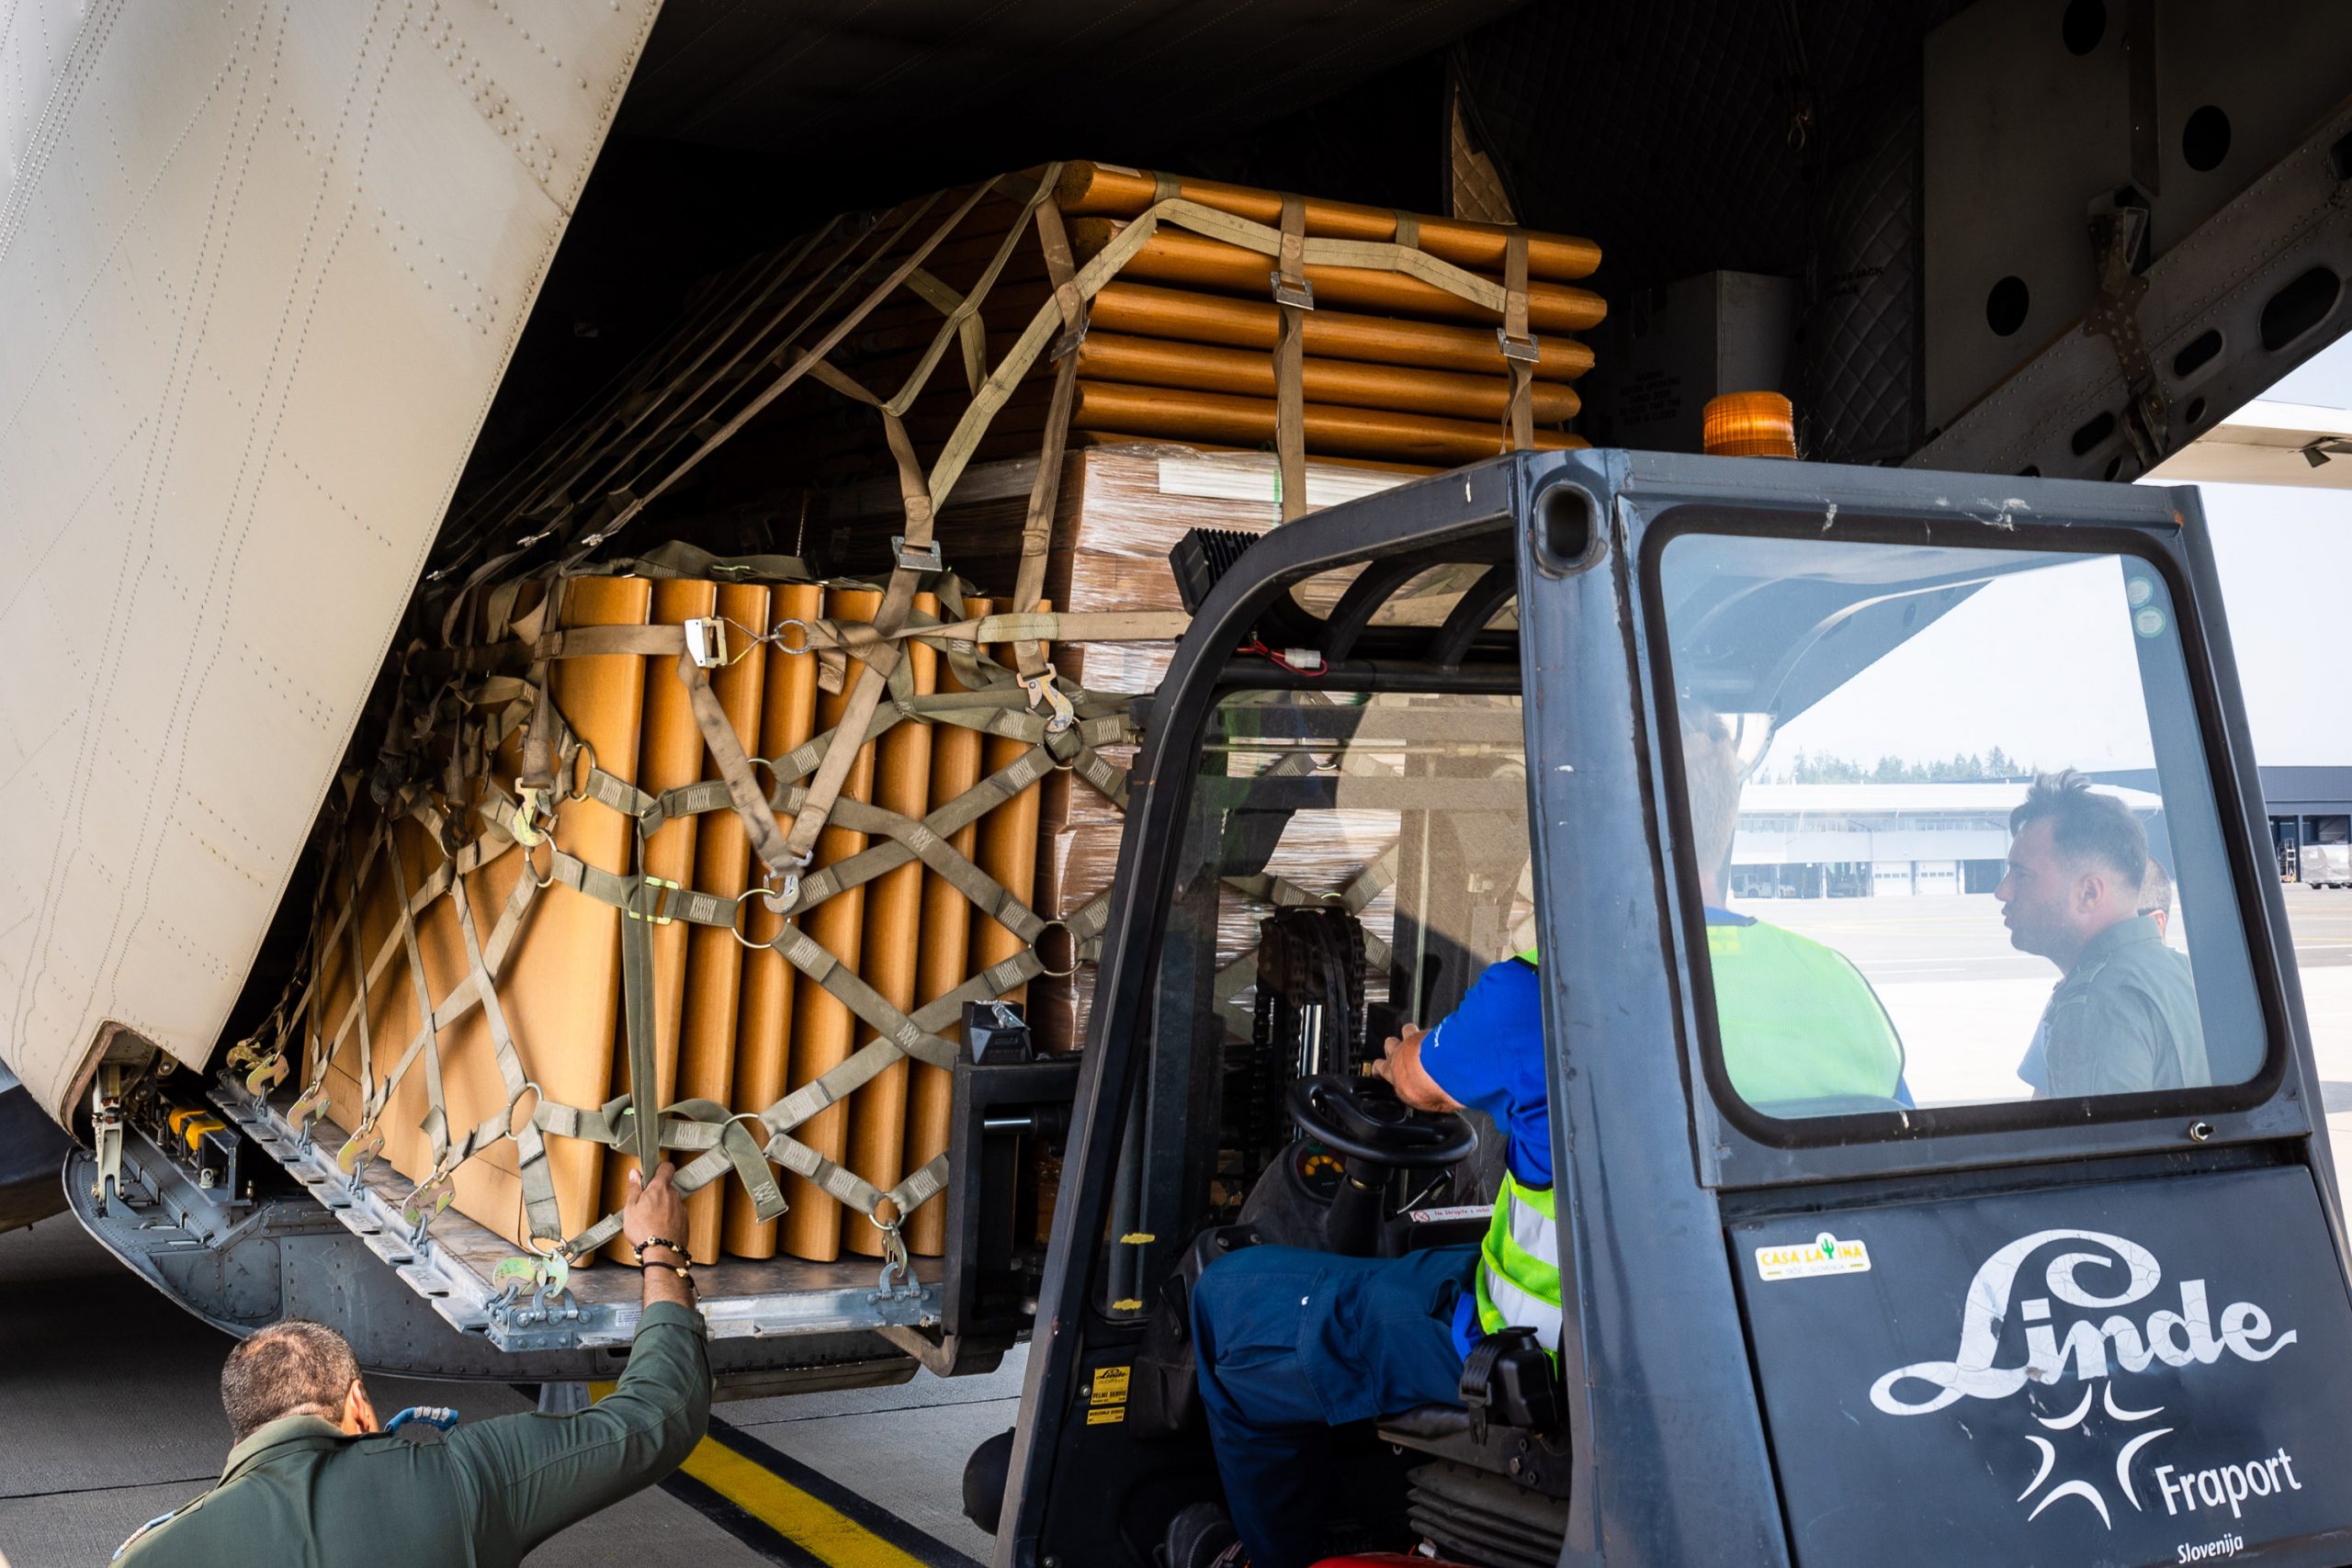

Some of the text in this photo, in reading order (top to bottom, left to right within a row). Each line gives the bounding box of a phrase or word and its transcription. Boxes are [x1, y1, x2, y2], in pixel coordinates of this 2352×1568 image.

[1645, 376, 1681, 390] OPERATING
[1652, 409, 1677, 422] CLOSED
[1761, 1251, 1800, 1266] CASA
[1870, 1229, 2297, 1416] Linde
[2154, 1448, 2302, 1518] Fraport
[2177, 1532, 2244, 1563] Slovenija
